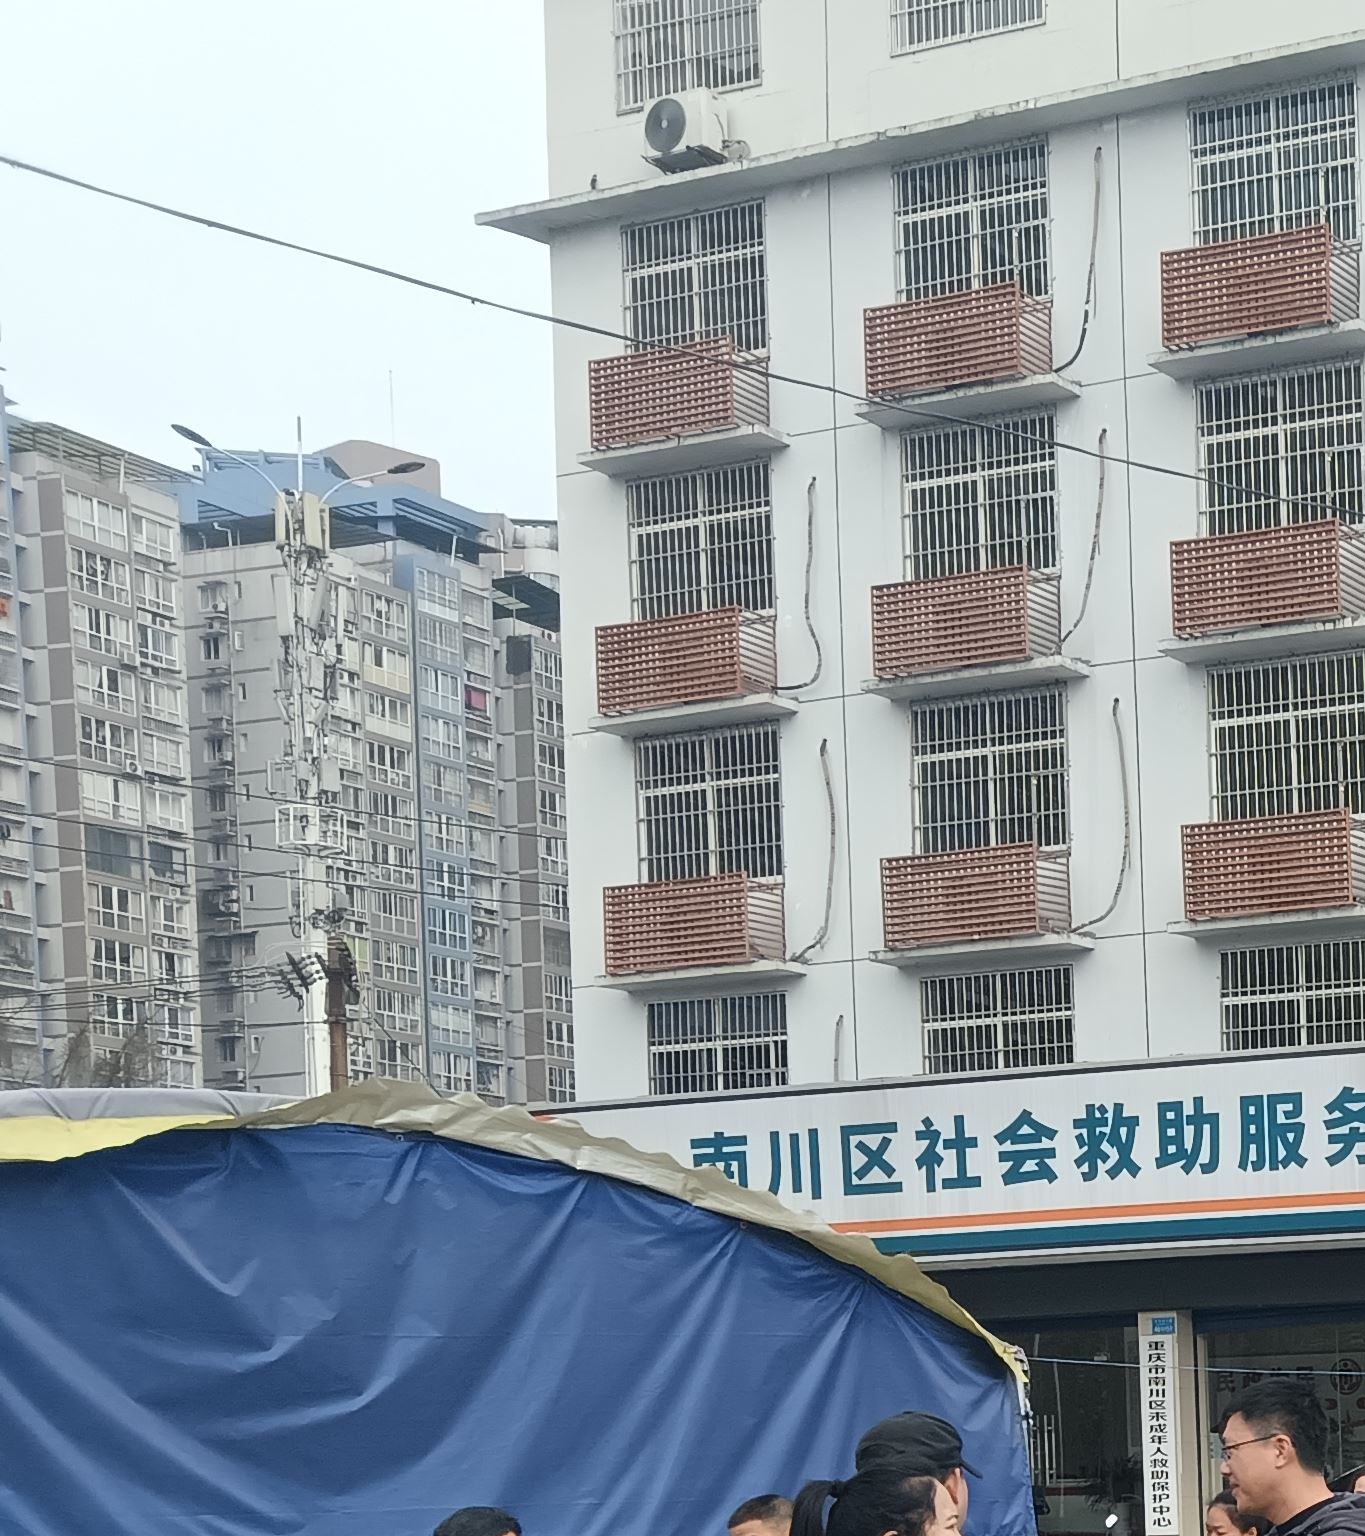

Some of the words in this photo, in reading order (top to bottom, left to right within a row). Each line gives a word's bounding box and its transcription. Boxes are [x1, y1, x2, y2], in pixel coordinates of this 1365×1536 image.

[1147, 1340, 1172, 1527] 重庆市南川区未成年人救助保护中心
